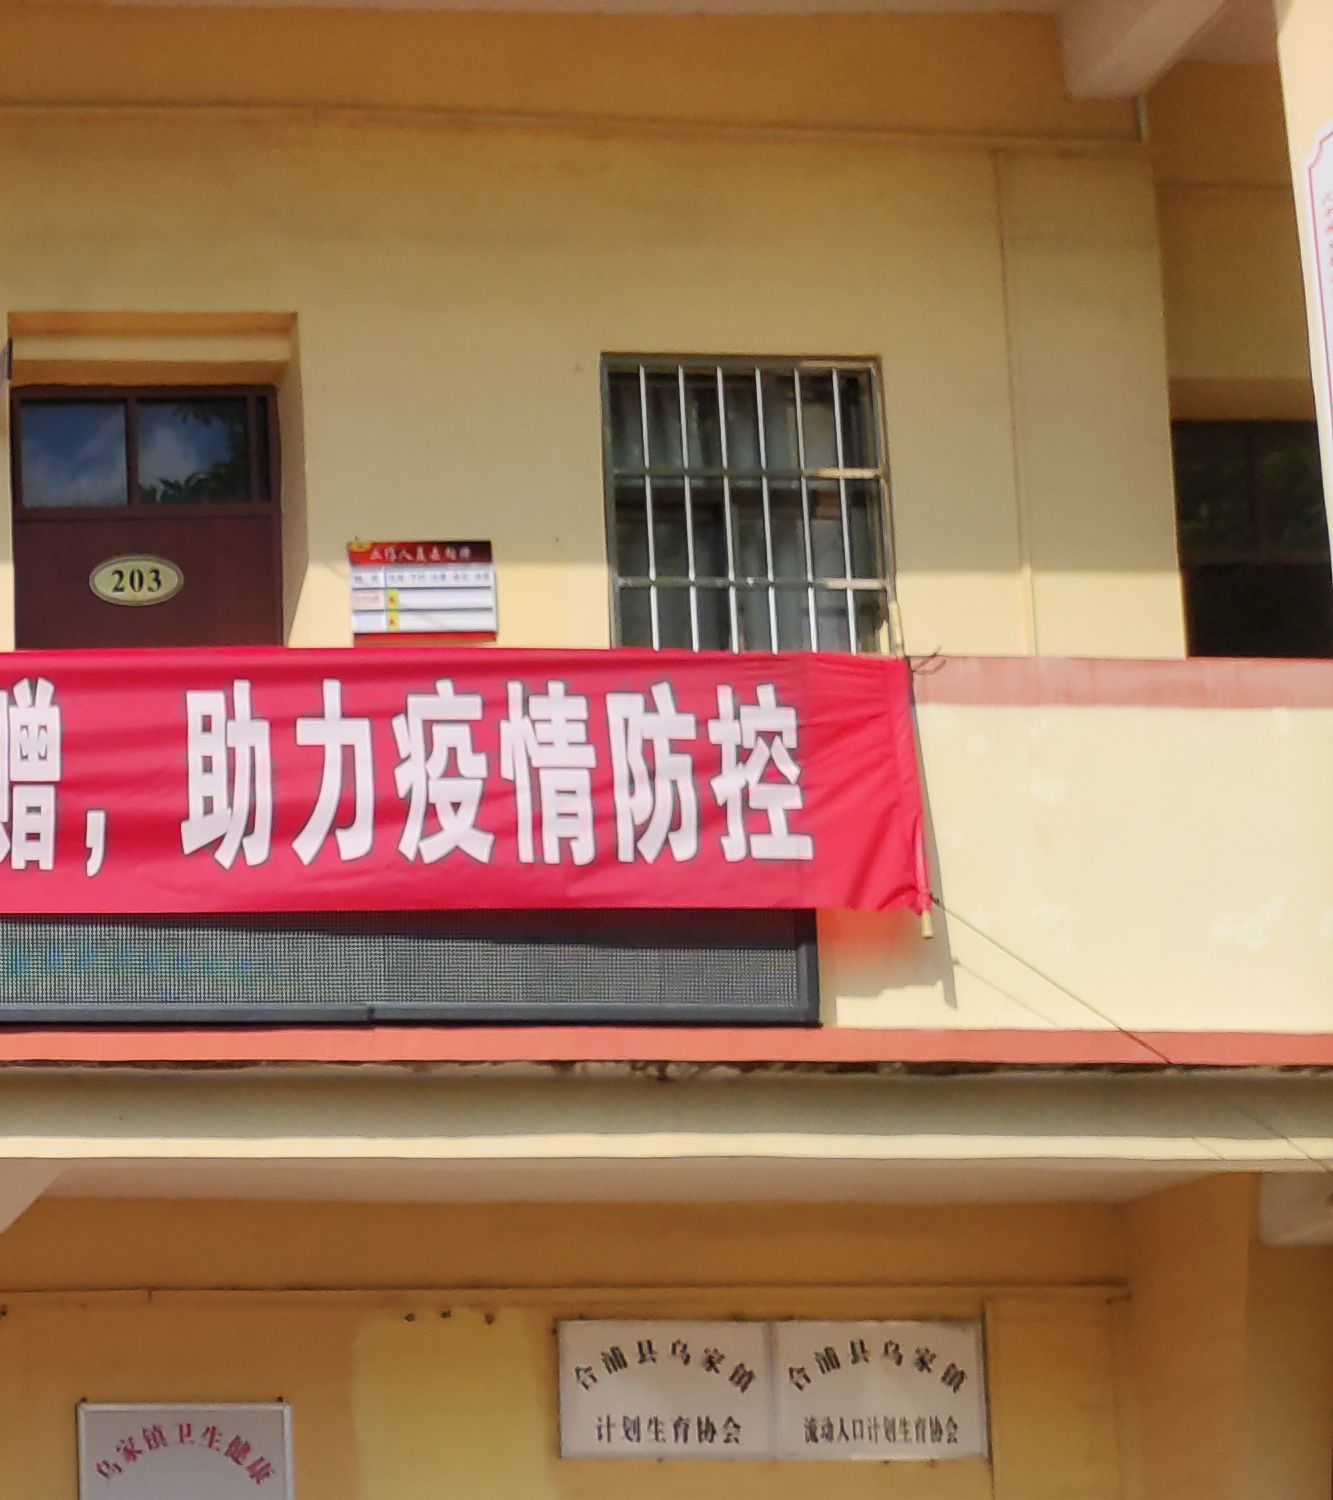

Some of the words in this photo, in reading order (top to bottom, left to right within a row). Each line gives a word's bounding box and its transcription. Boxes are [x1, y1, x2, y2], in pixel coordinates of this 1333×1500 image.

[111, 568, 162, 593] 203
[573, 1337, 757, 1394] 合浦县乌家镇
[787, 1337, 969, 1395] 合浦县乌家镇
[595, 1414, 742, 1445] 计划生育协会
[802, 1414, 960, 1446] 流动人口计划生育协会
[95, 1422, 276, 1486] 乌家镇卫生健康
